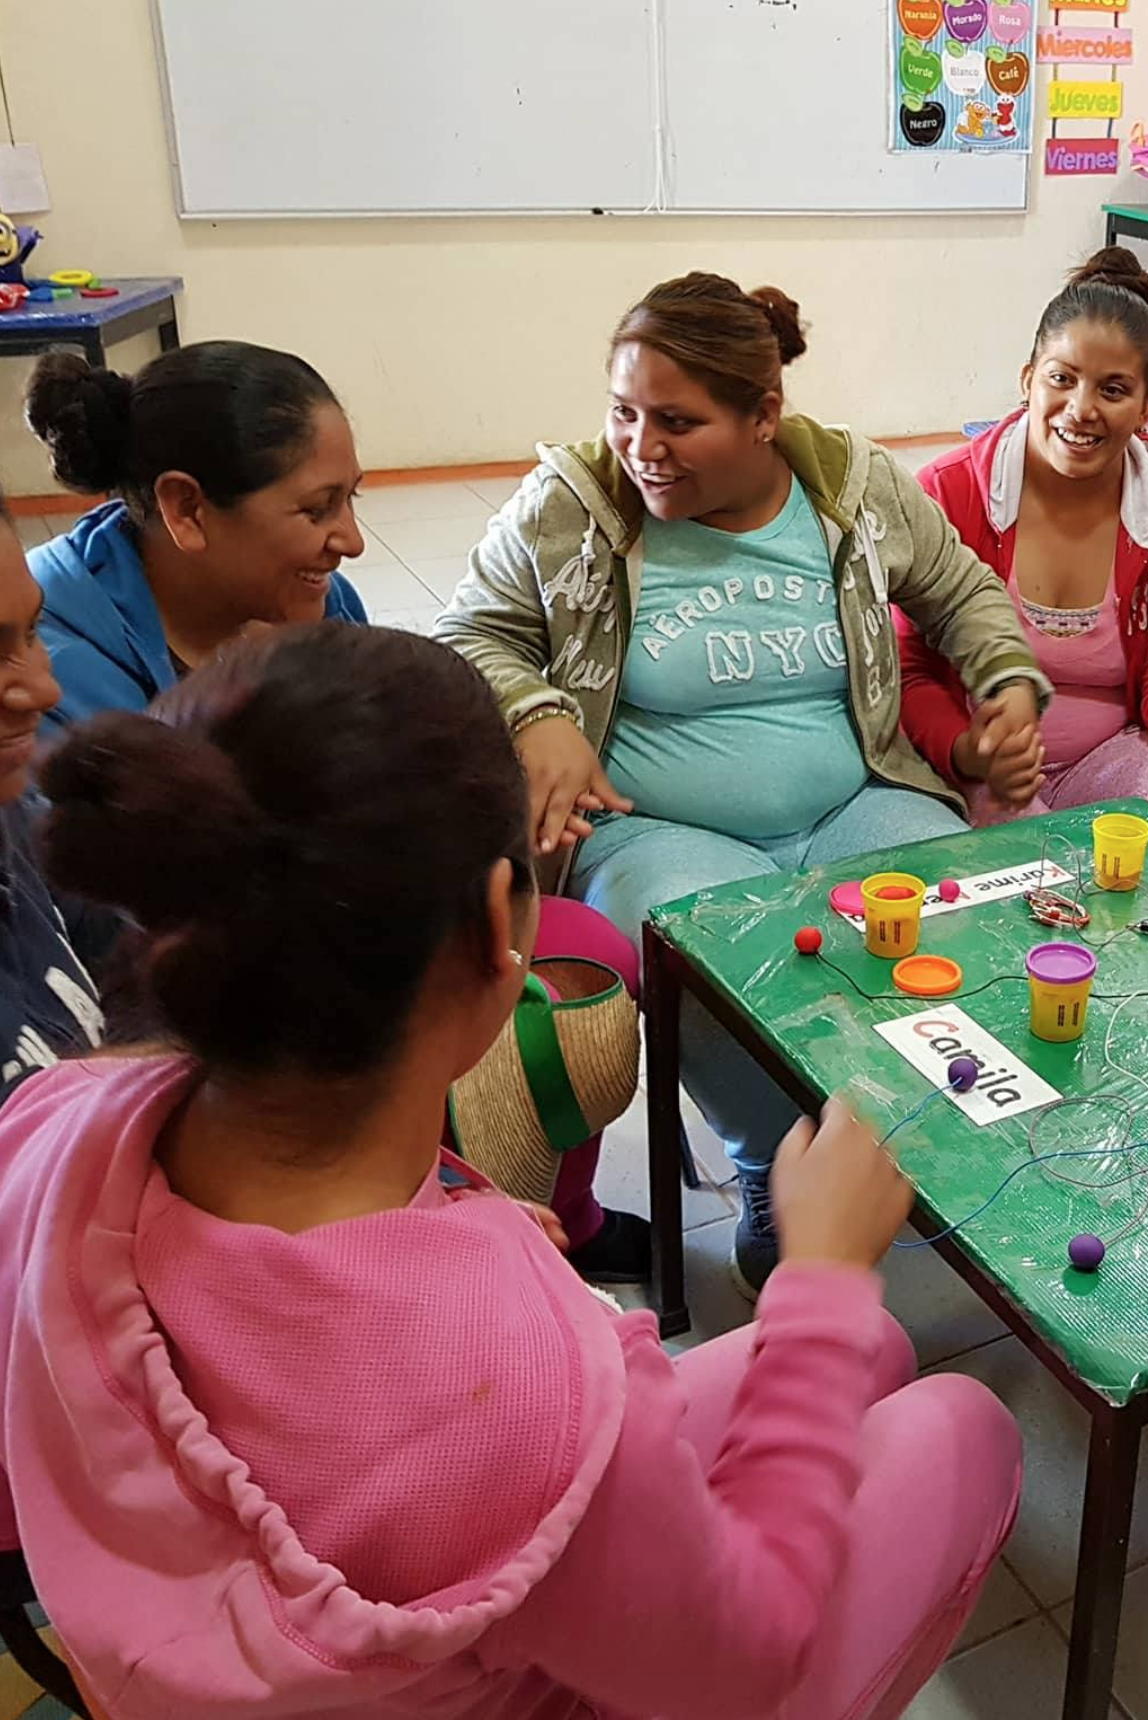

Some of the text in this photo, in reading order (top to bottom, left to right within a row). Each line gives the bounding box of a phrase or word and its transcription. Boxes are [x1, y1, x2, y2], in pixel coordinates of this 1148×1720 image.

[952, 13, 982, 26] Morado
[998, 15, 1021, 26] Rosa
[907, 64, 934, 79] Verde
[950, 66, 979, 77] Blanco
[998, 66, 1019, 81] Café
[1049, 87, 1118, 112] Jueves
[909, 118, 938, 130] Negro
[1047, 145, 1118, 171] Viernes
[641, 574, 838, 661] AEROPOST
[704, 620, 850, 686] NYC
[974, 865, 1066, 893] Karime
